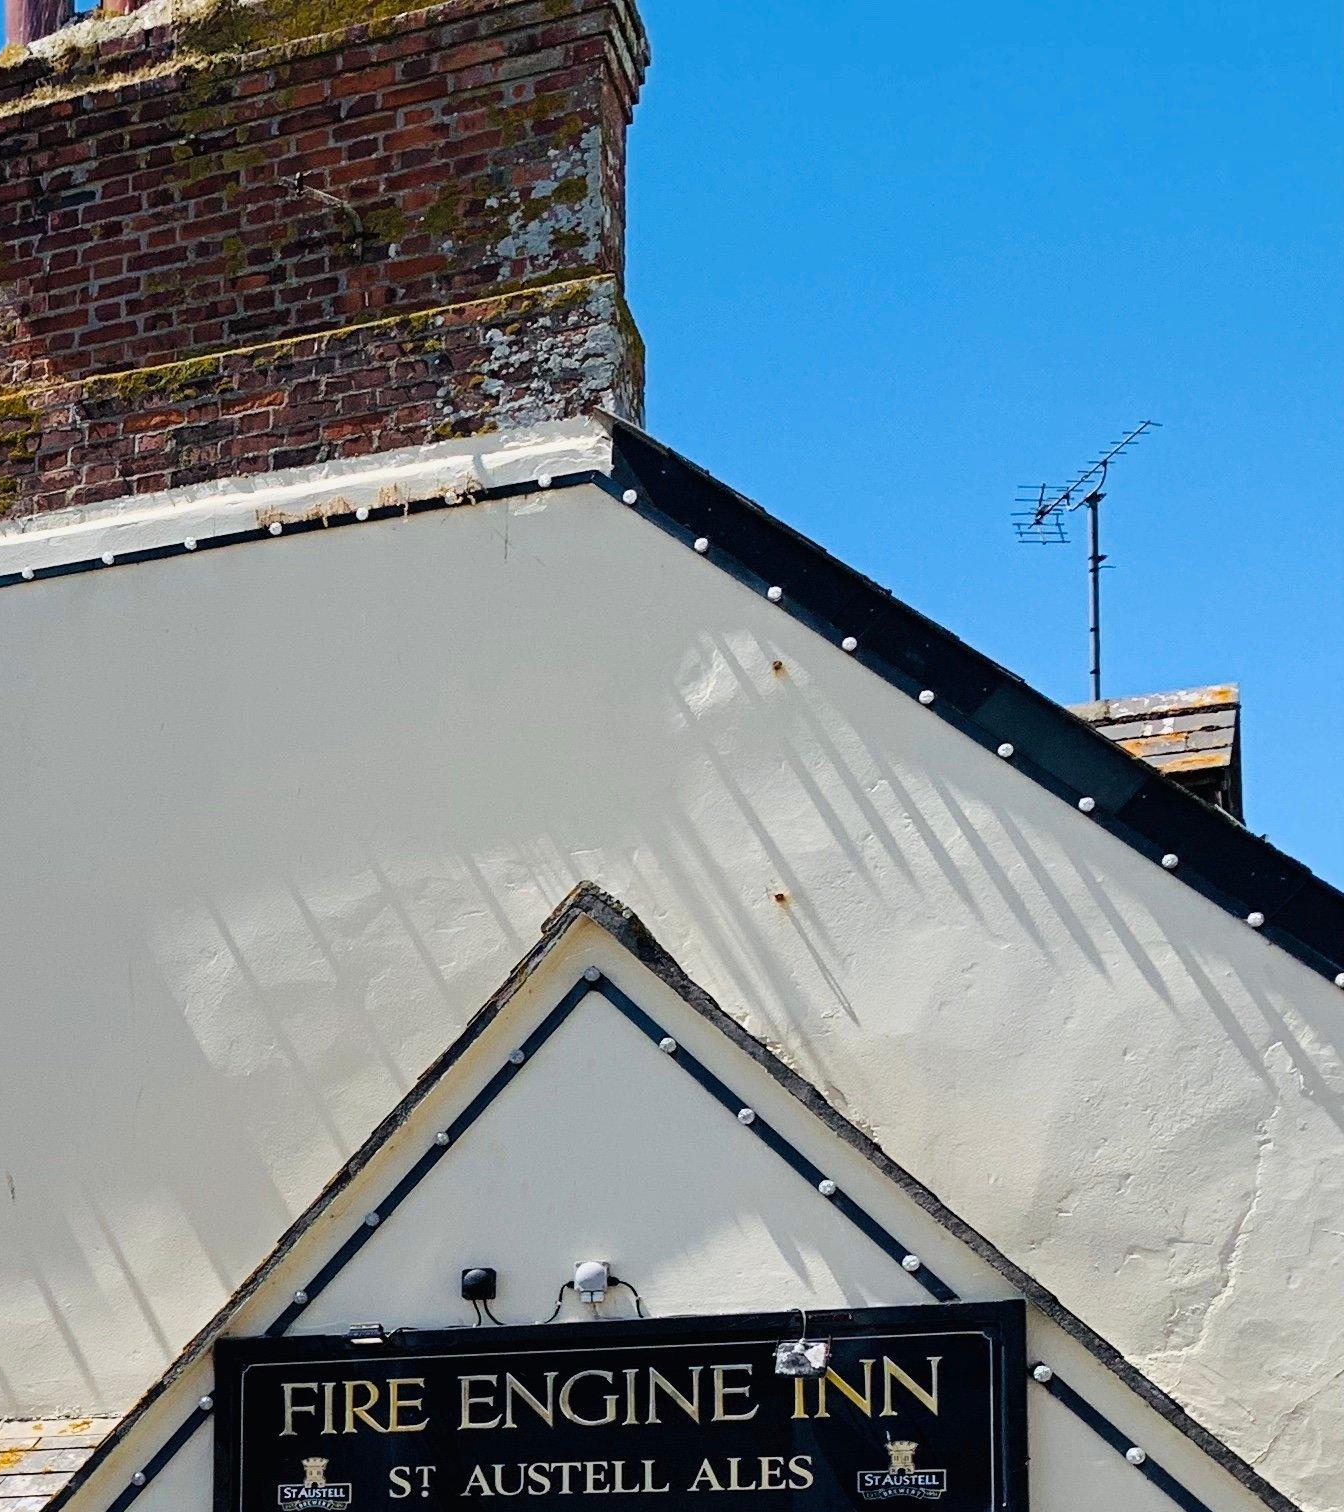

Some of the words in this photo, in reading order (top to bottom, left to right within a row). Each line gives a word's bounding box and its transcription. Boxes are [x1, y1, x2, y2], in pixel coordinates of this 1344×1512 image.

[279, 1377, 430, 1436] FIRE
[457, 1363, 760, 1431] ENGINE
[791, 1355, 944, 1419] INN
[460, 1459, 669, 1497] AUSTELL
[687, 1454, 815, 1492] ALES
[865, 1473, 881, 1487] ST
[881, 1473, 940, 1486] AUSTELL
[283, 1486, 297, 1499] ST
[297, 1486, 346, 1499] AUSTELL
